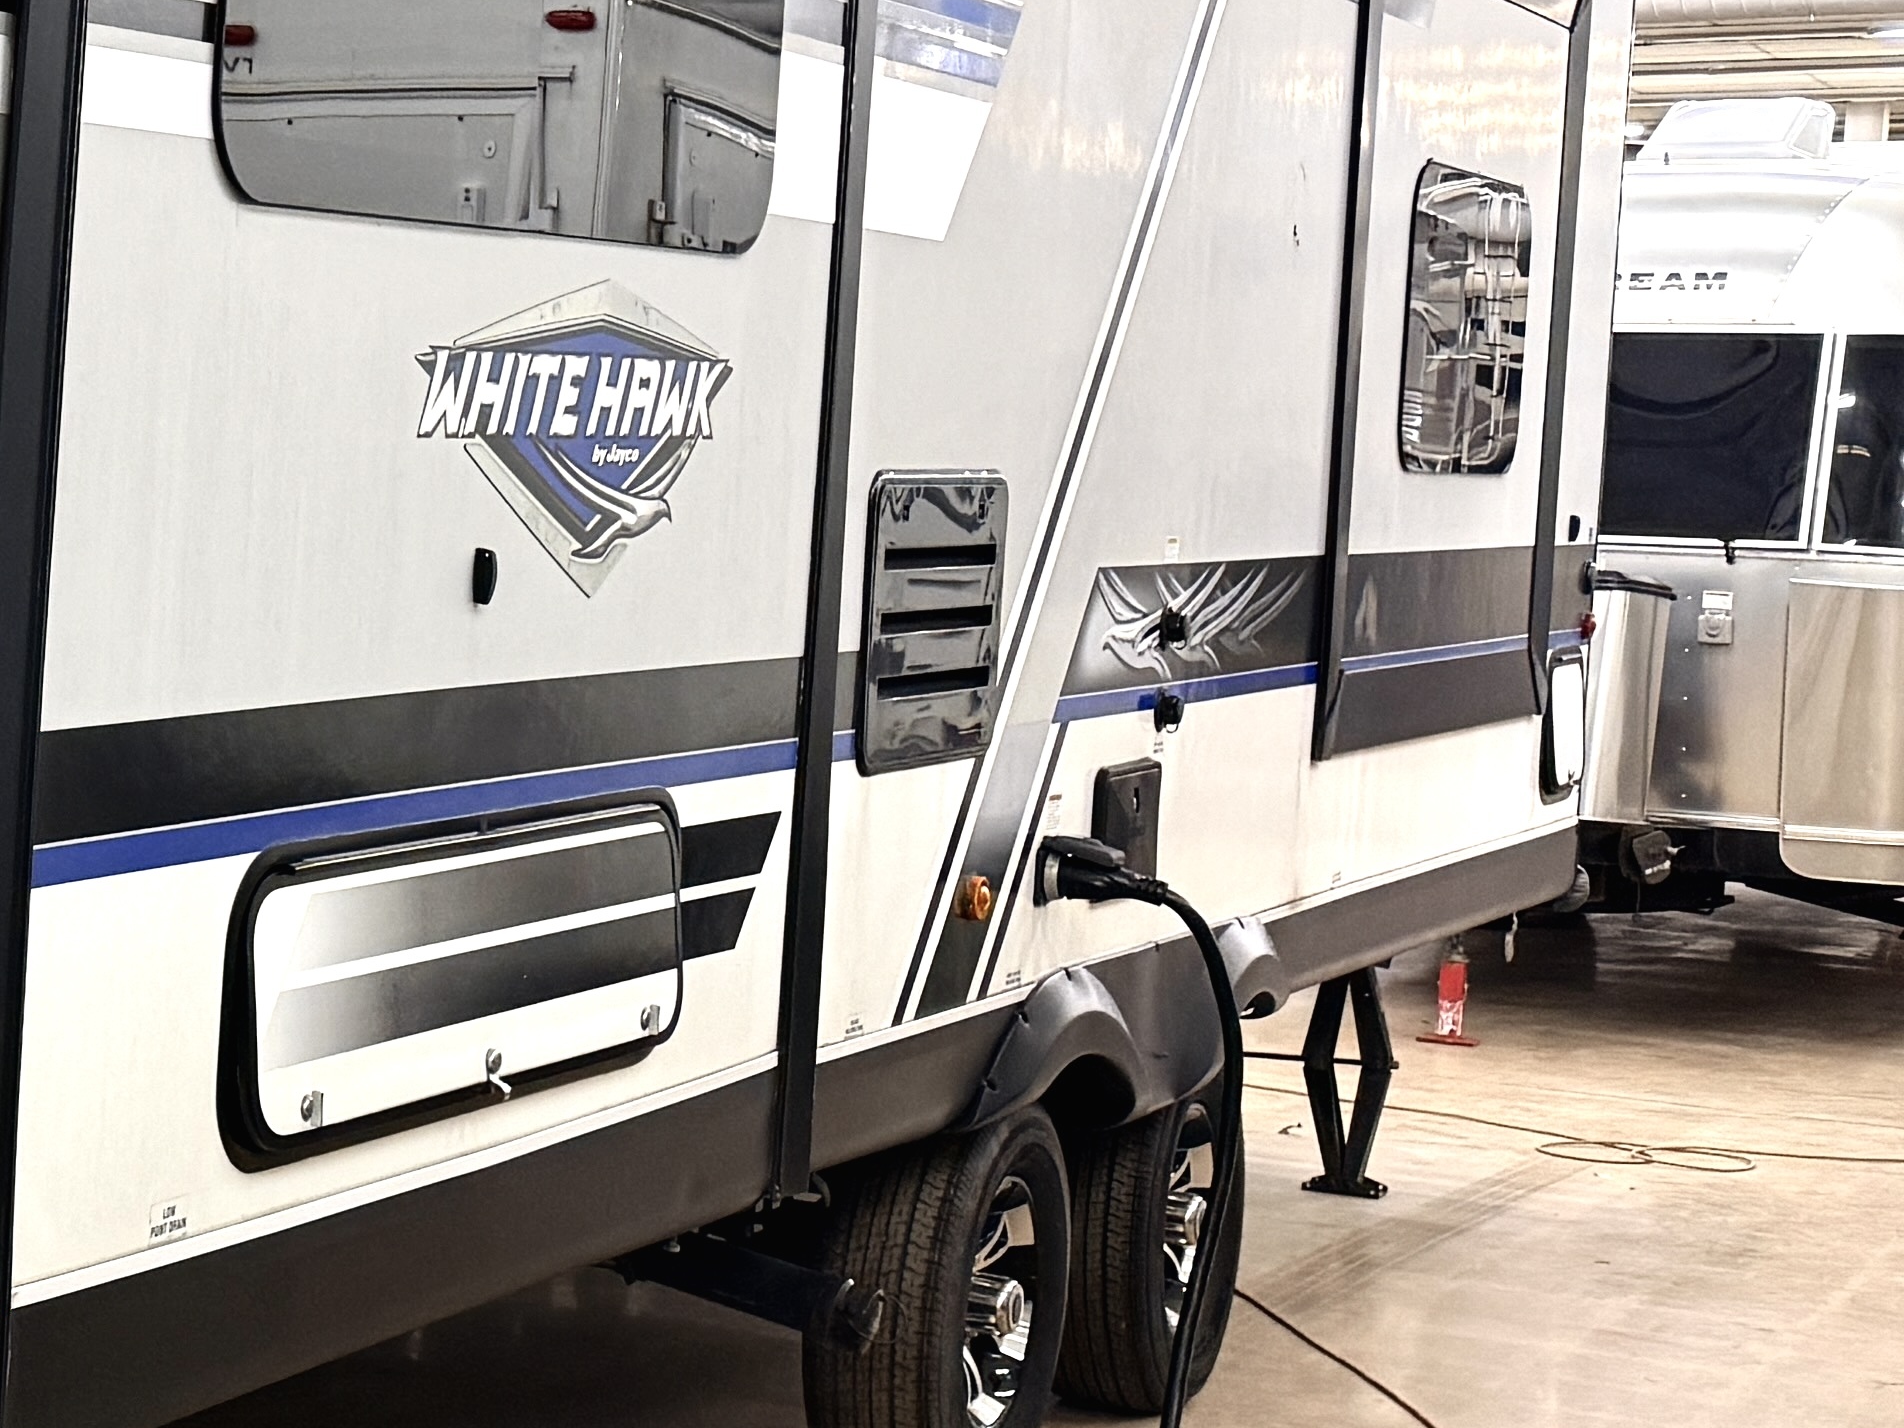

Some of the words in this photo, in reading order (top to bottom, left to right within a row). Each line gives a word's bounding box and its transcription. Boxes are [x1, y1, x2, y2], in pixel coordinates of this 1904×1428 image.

[1614, 271, 1728, 291] EAM
[417, 349, 590, 438] WHITE
[585, 355, 727, 439] HAWK
[591, 443, 608, 467] by
[606, 443, 640, 467] Jayco
